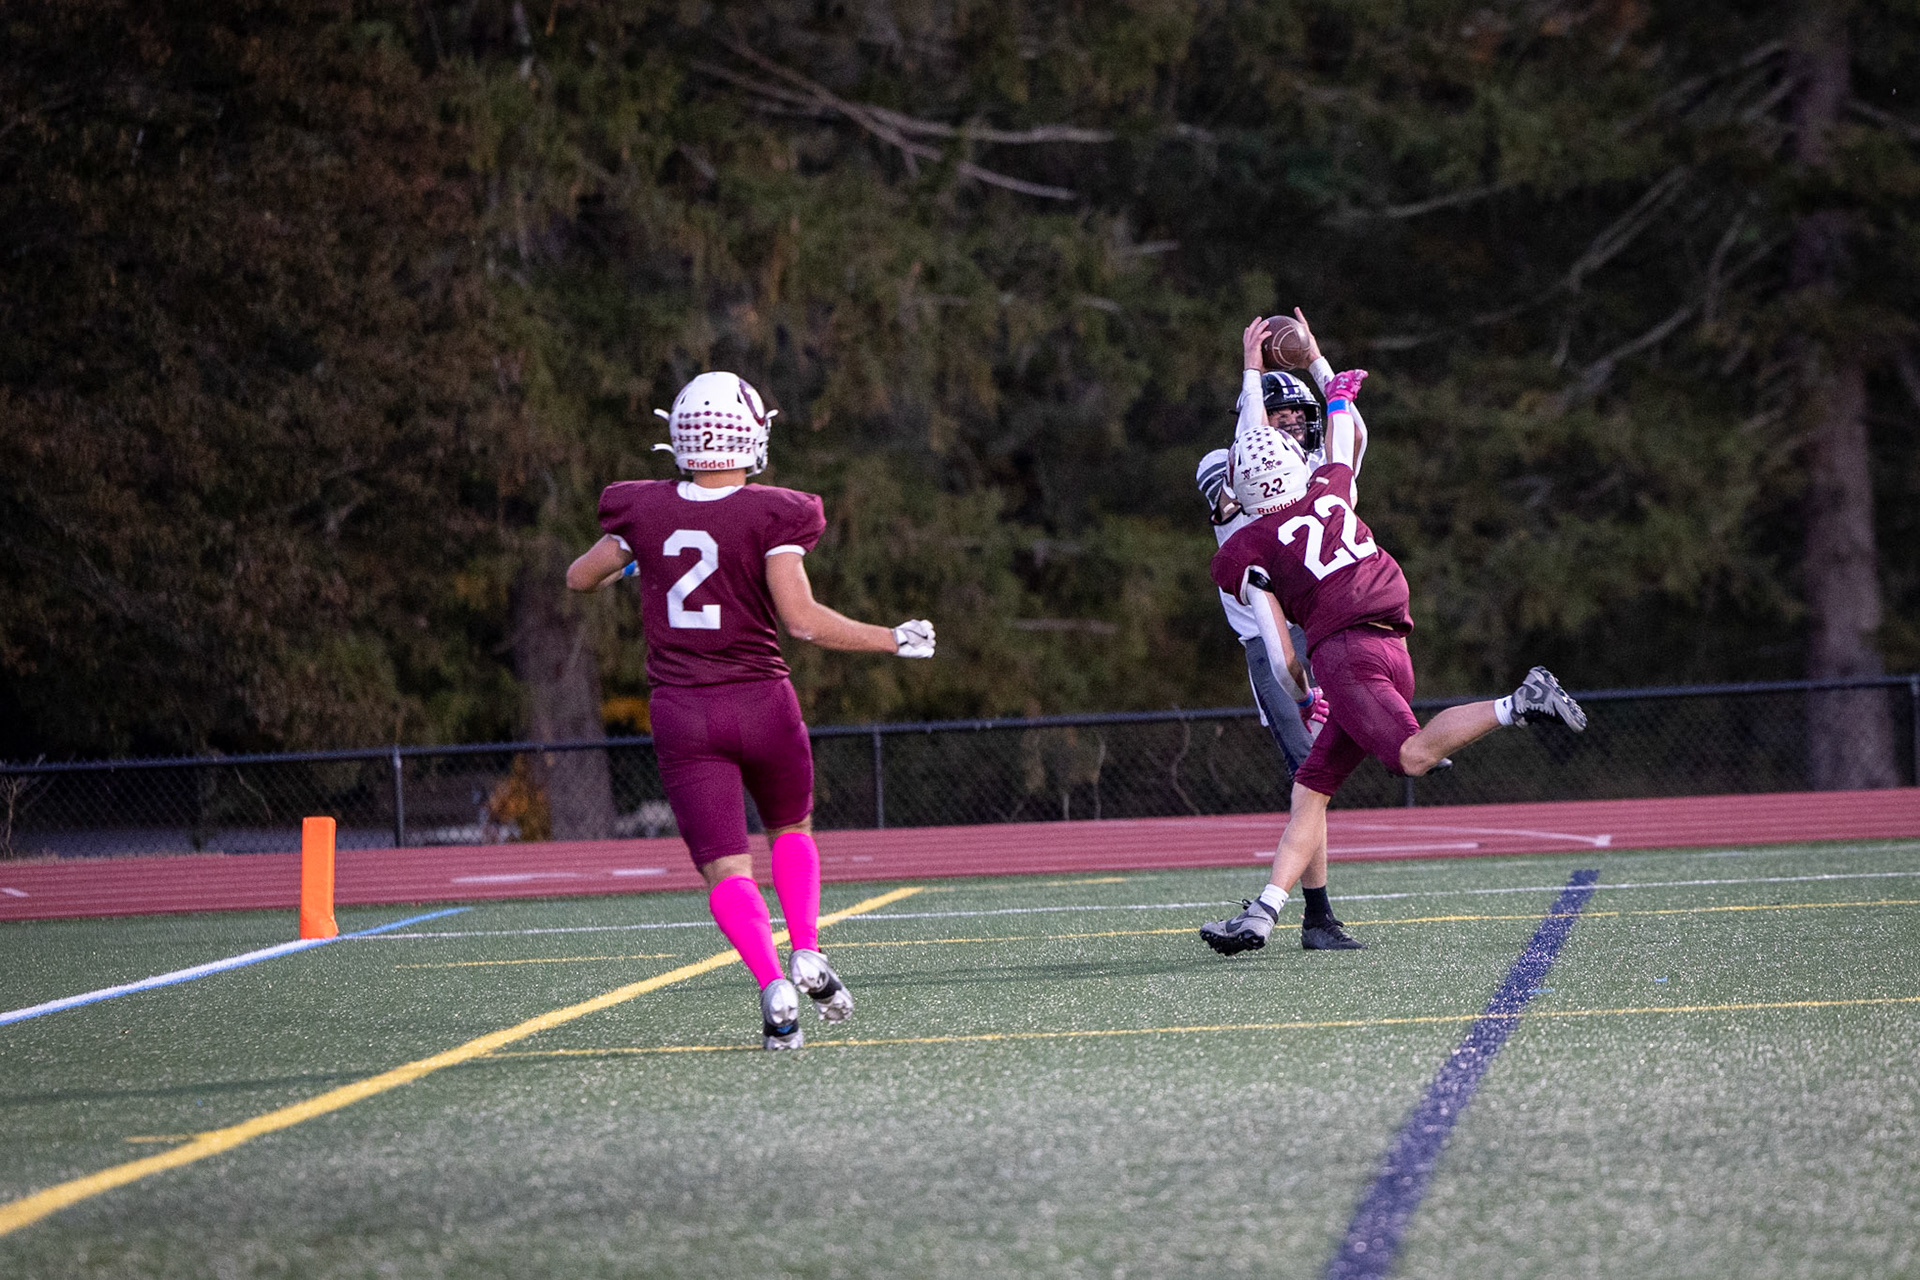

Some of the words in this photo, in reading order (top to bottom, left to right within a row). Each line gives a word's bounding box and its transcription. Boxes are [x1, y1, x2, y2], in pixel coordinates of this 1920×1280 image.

[702, 431, 714, 451] 2
[687, 458, 735, 469] Riddell
[1260, 477, 1285, 498] 22
[1277, 494, 1378, 581] 22
[663, 530, 721, 630] 2
